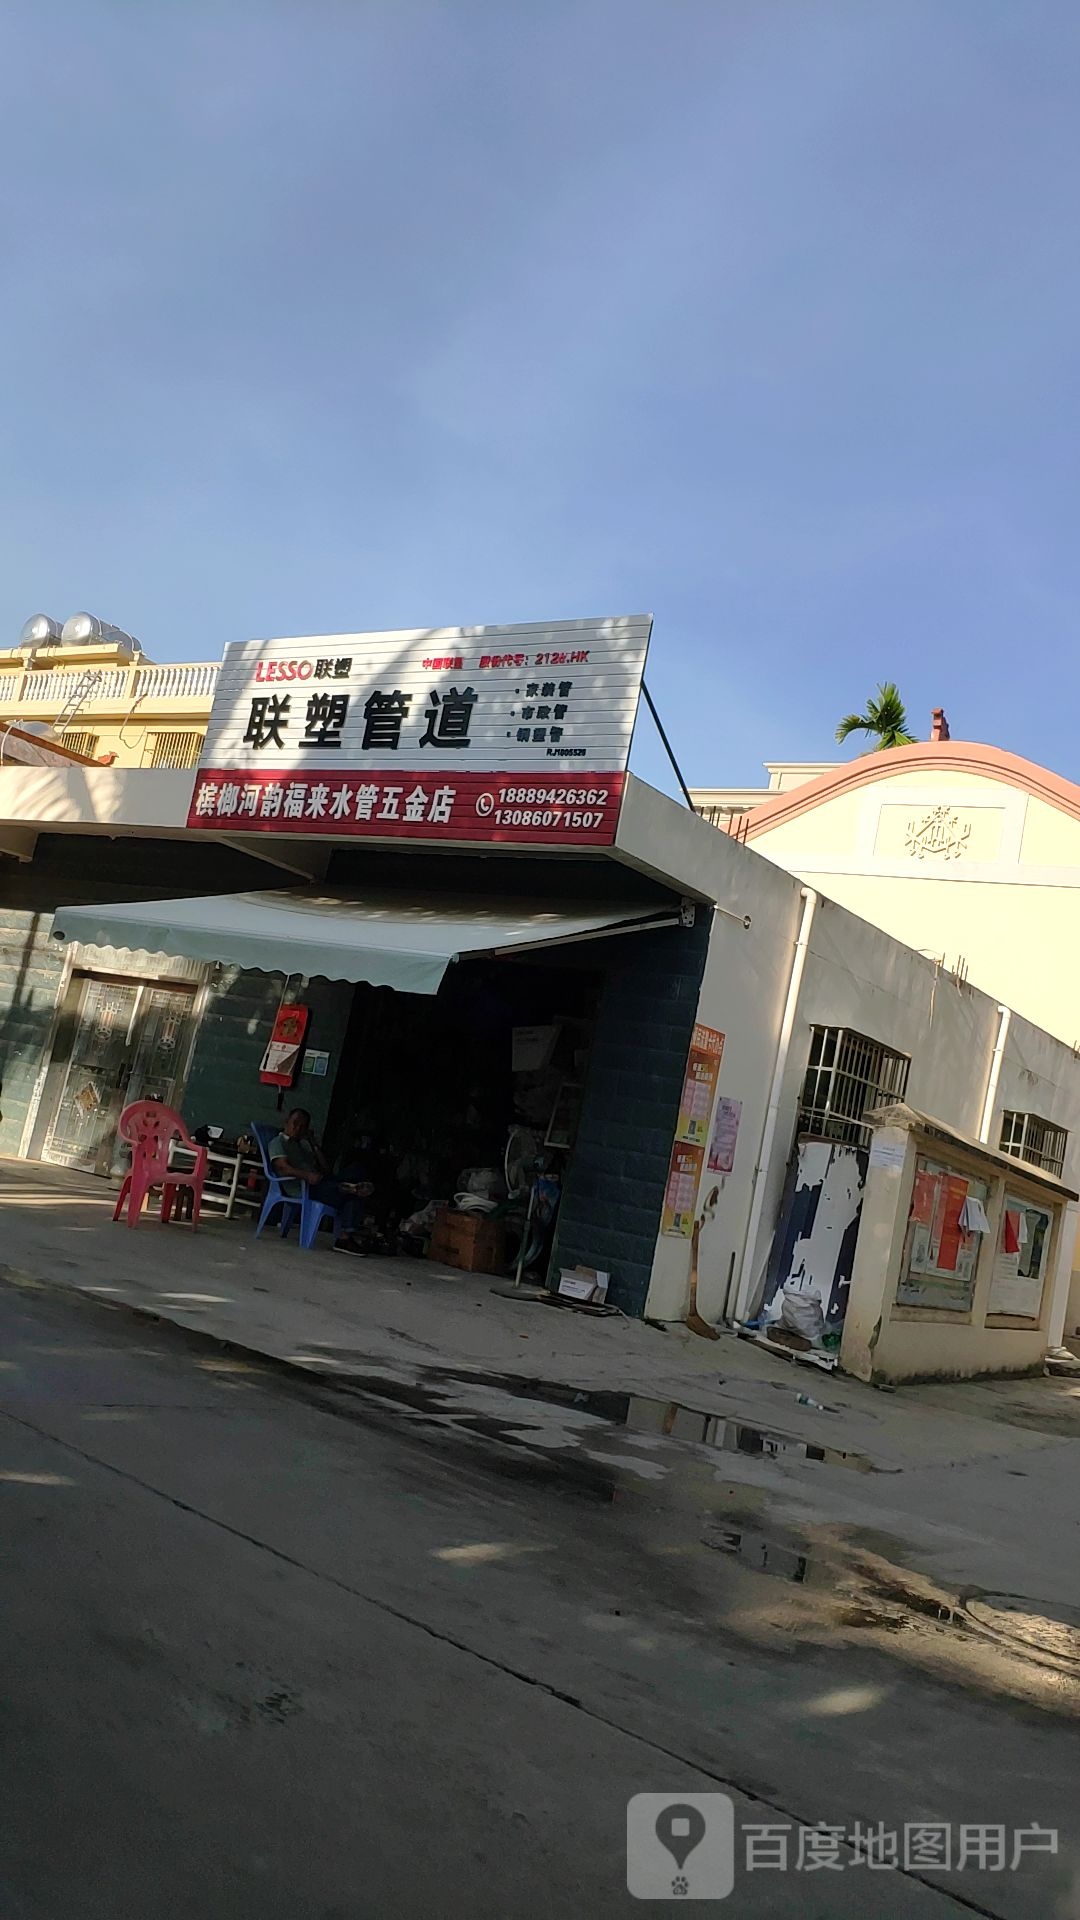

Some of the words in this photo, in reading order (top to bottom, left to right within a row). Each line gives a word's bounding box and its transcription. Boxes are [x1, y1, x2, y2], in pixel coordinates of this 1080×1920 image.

[255, 660, 314, 682] LESSO
[243, 686, 479, 750] 联塑管道
[195, 782, 457, 823] 槟榔河韵福来水管五金店
[498, 787, 609, 806] 18889426362
[493, 809, 604, 828] 13086071507
